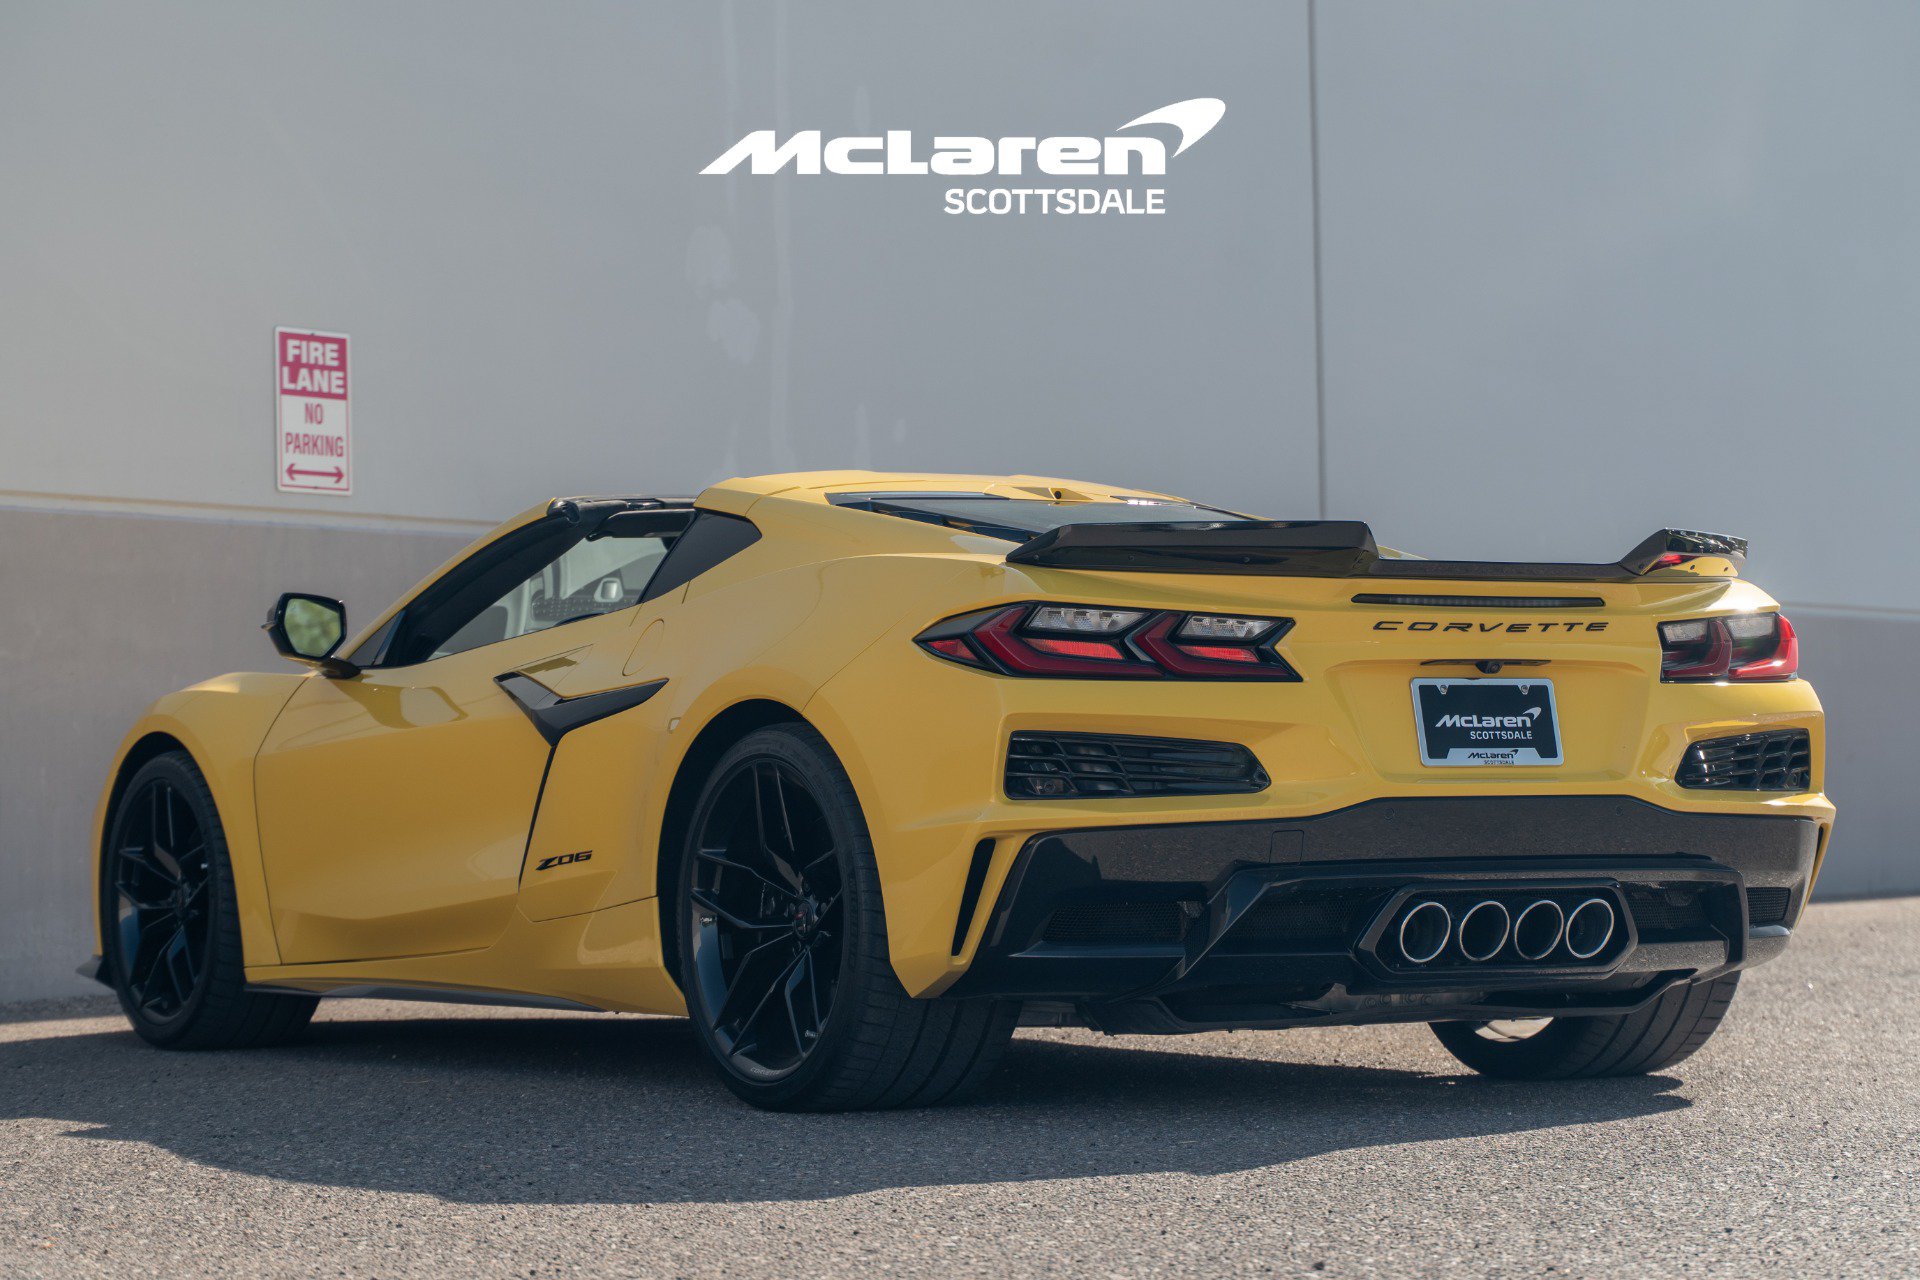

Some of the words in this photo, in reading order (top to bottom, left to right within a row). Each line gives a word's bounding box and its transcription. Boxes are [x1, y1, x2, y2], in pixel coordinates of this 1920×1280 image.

[286, 339, 339, 366] FIRE
[282, 366, 345, 394] LANE
[304, 403, 323, 424] NO
[285, 432, 344, 458] PARKING
[1372, 620, 1609, 633] CORVETTE
[1435, 714, 1532, 728] McLaren
[1470, 731, 1533, 740] SCOTTSDALE
